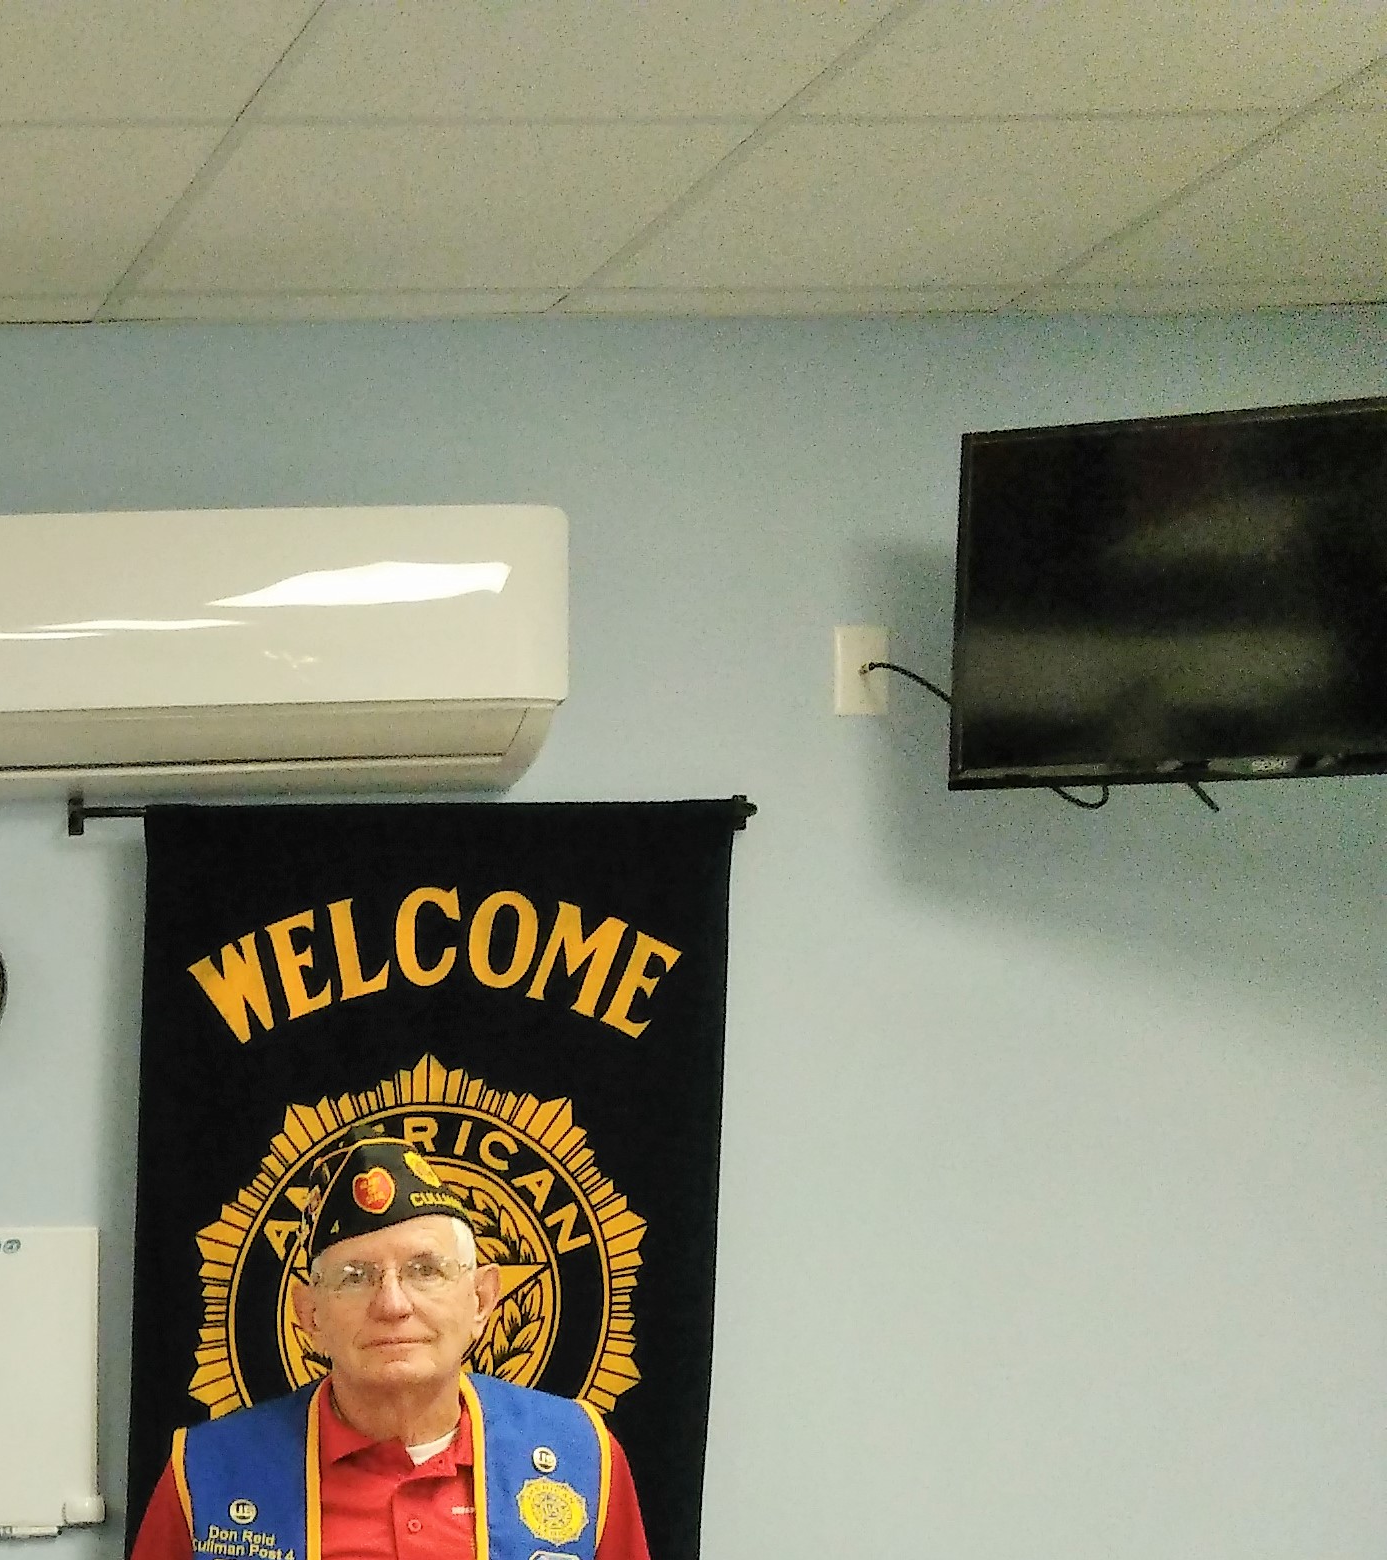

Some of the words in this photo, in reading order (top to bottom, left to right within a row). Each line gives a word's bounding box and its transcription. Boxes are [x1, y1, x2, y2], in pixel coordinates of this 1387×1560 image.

[187, 885, 682, 1045] WELCOME
[264, 1116, 592, 1262] ARICAN
[209, 1524, 238, 1542] Don
